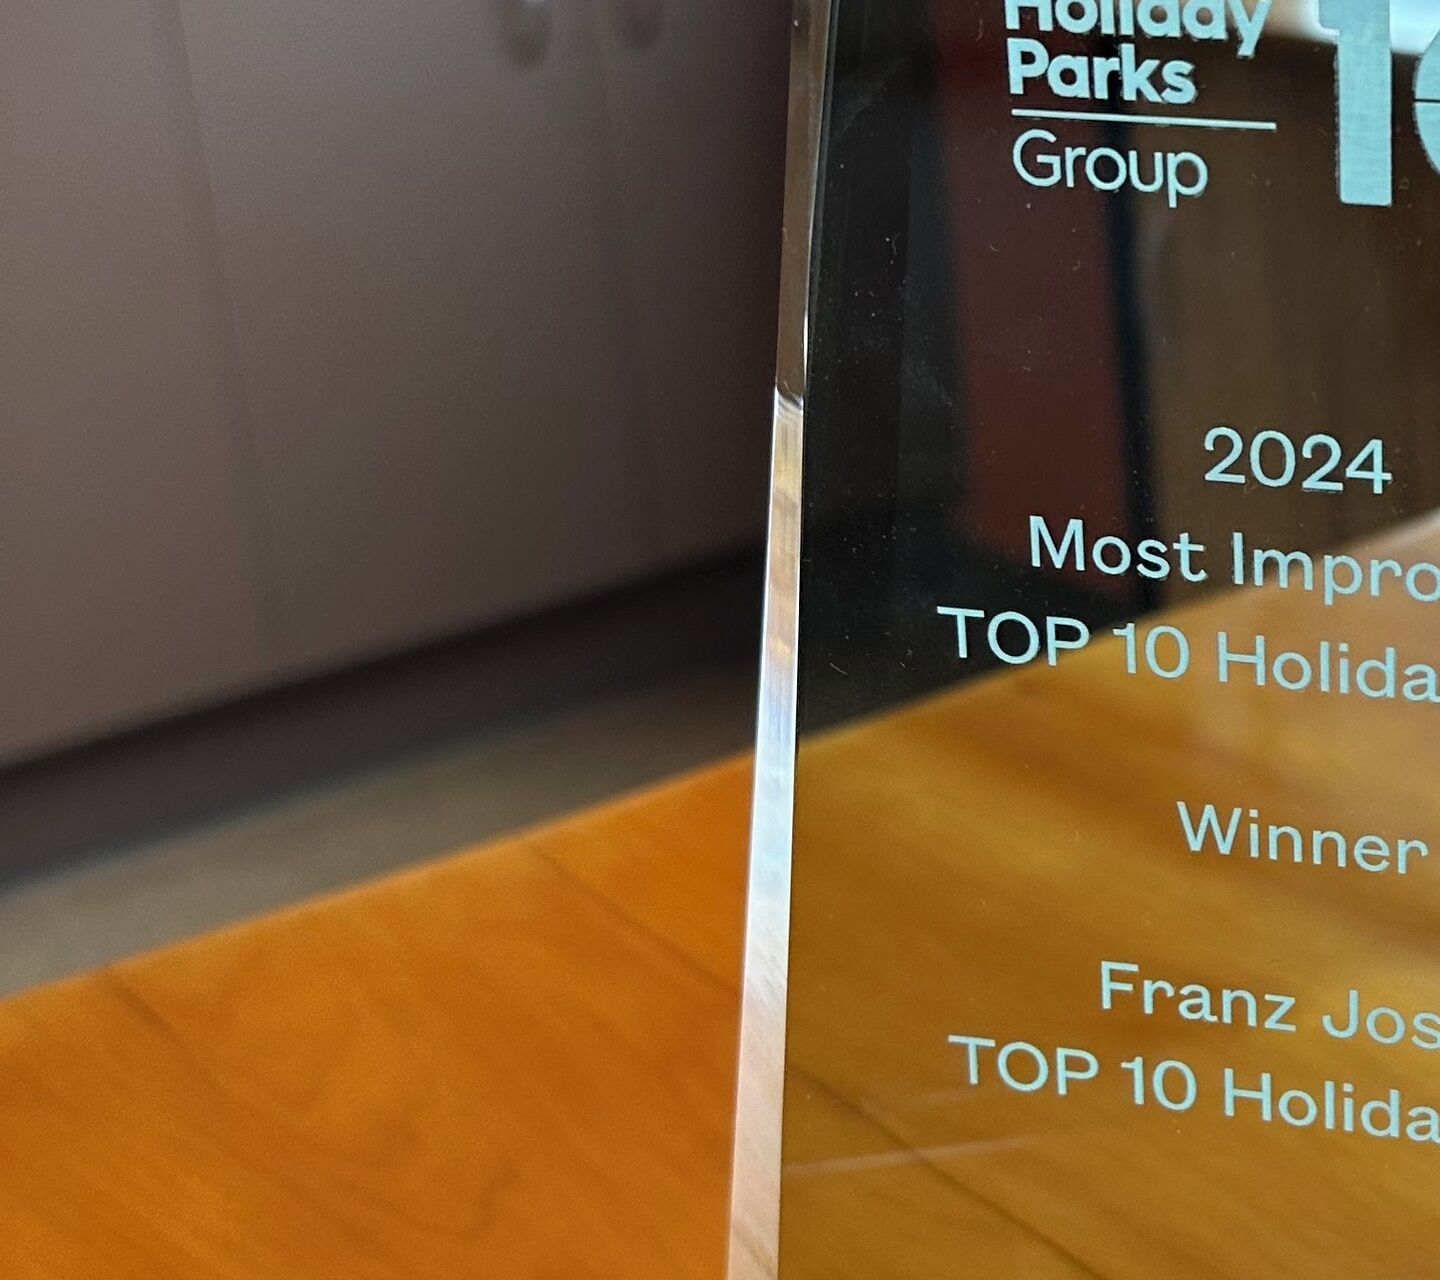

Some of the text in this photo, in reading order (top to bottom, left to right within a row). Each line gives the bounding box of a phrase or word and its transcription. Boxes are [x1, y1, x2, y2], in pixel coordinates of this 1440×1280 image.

[1007, 38, 1197, 106] Parks
[1012, 129, 1208, 208] Group
[1203, 426, 1393, 495] 2024
[1029, 515, 1208, 583] Most
[936, 605, 1091, 667] TOP
[1113, 622, 1191, 680] 10
[1175, 801, 1429, 875] Winner
[1100, 960, 1296, 1032] Franz
[948, 1033, 1099, 1096] TOP
[1120, 1055, 1197, 1112] 10
